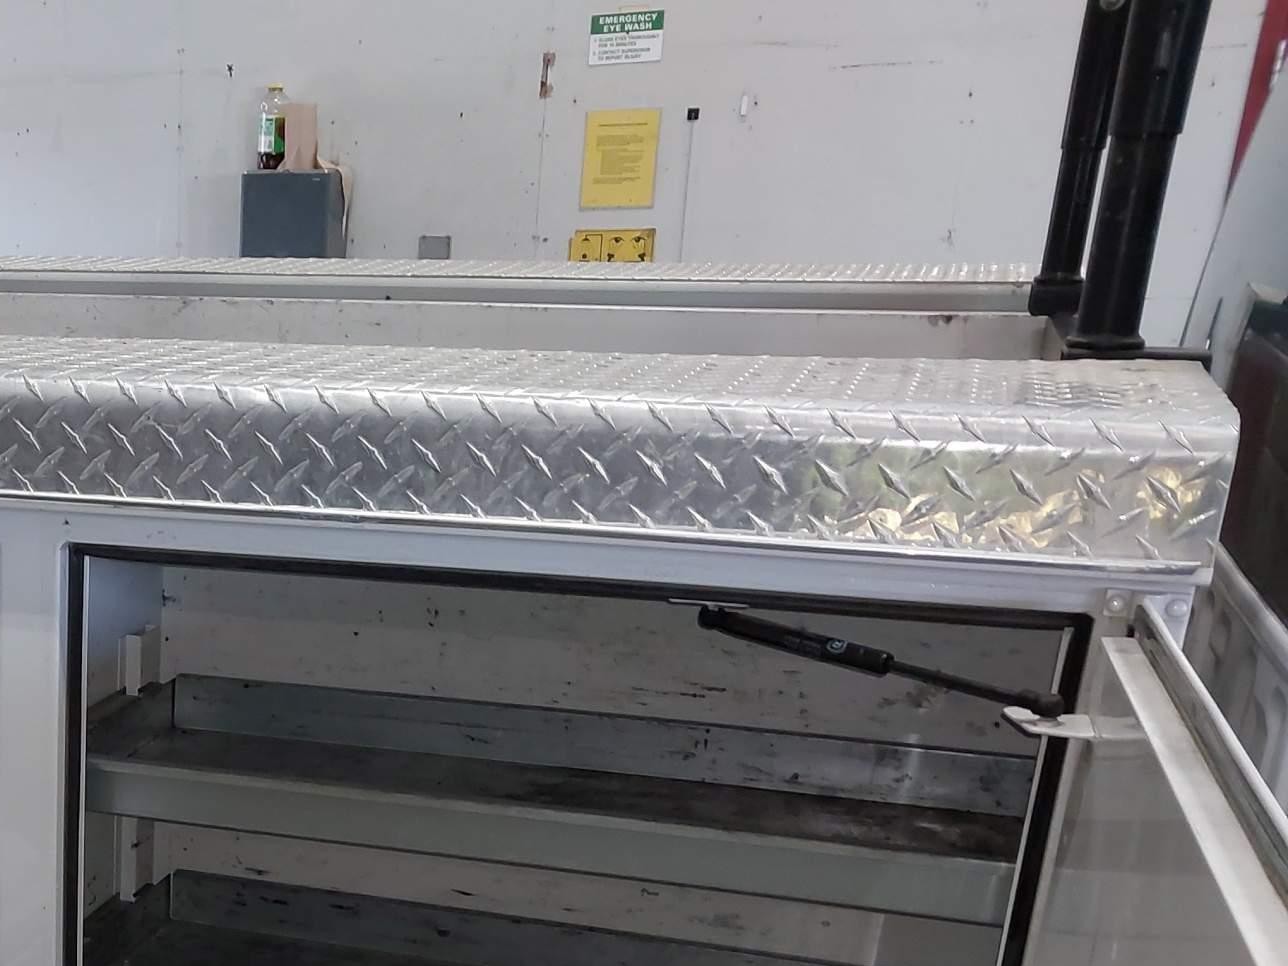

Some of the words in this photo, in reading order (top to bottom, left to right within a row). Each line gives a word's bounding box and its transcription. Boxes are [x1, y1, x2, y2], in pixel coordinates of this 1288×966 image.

[599, 13, 658, 24] EMERGENCY
[603, 24, 621, 33] EYE
[624, 22, 652, 31] WASH
